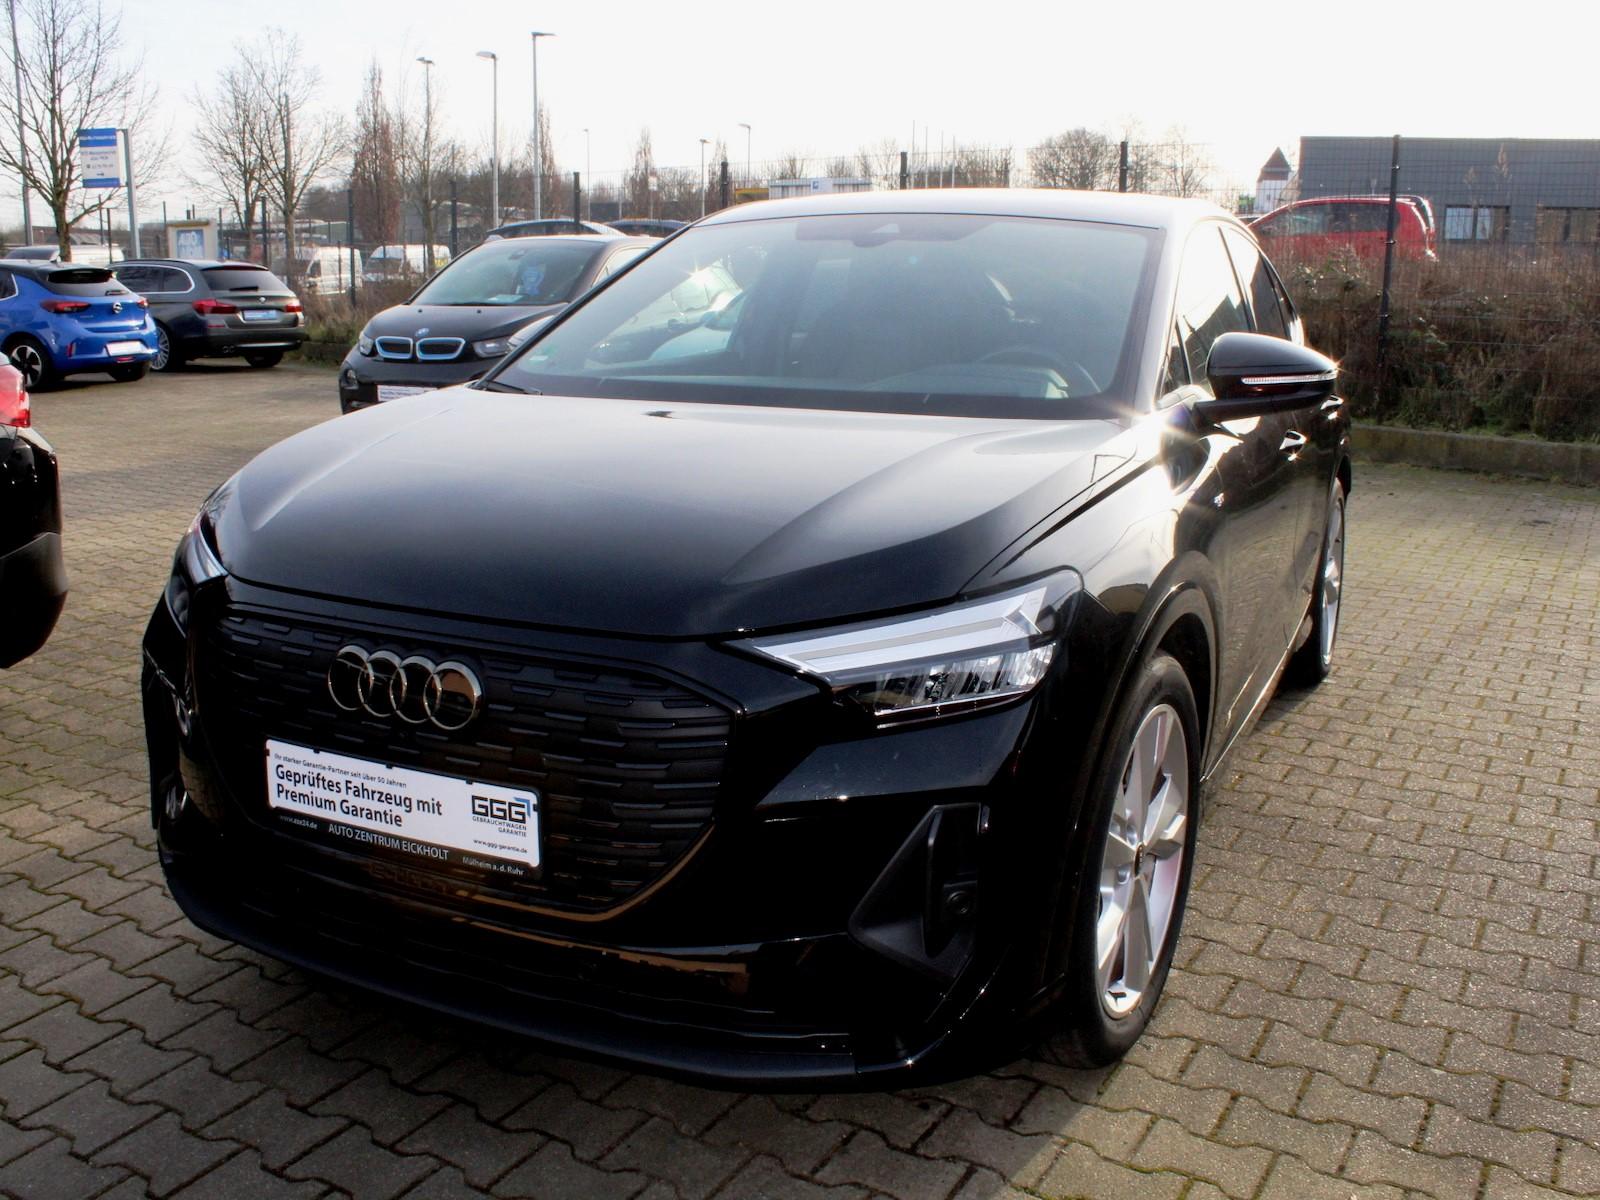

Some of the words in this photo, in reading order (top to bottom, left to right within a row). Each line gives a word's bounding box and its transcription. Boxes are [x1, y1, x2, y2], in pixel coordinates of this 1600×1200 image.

[283, 755, 302, 765] starker
[302, 759, 349, 776] Garantie-Partner
[350, 770, 361, 779] seit
[362, 771, 376, 782] über
[377, 776, 385, 784] 50
[386, 778, 407, 788] Jahren
[276, 764, 342, 794] Geprüftes
[345, 780, 412, 813] Fahrzeug
[416, 797, 443, 816] mit
[277, 783, 336, 812] Premium
[340, 799, 403, 827] Garantie
[472, 795, 527, 825] GGG
[472, 815, 527, 831] GEBRAUCHTWAGEN
[328, 823, 354, 838] AUTO
[355, 829, 401, 849] ZENTRUM
[402, 840, 449, 861] EICKHOLT
[498, 827, 527, 838] GARANTIE
[462, 856, 492, 871] Mülheim
[507, 866, 525, 877] Ruhr
